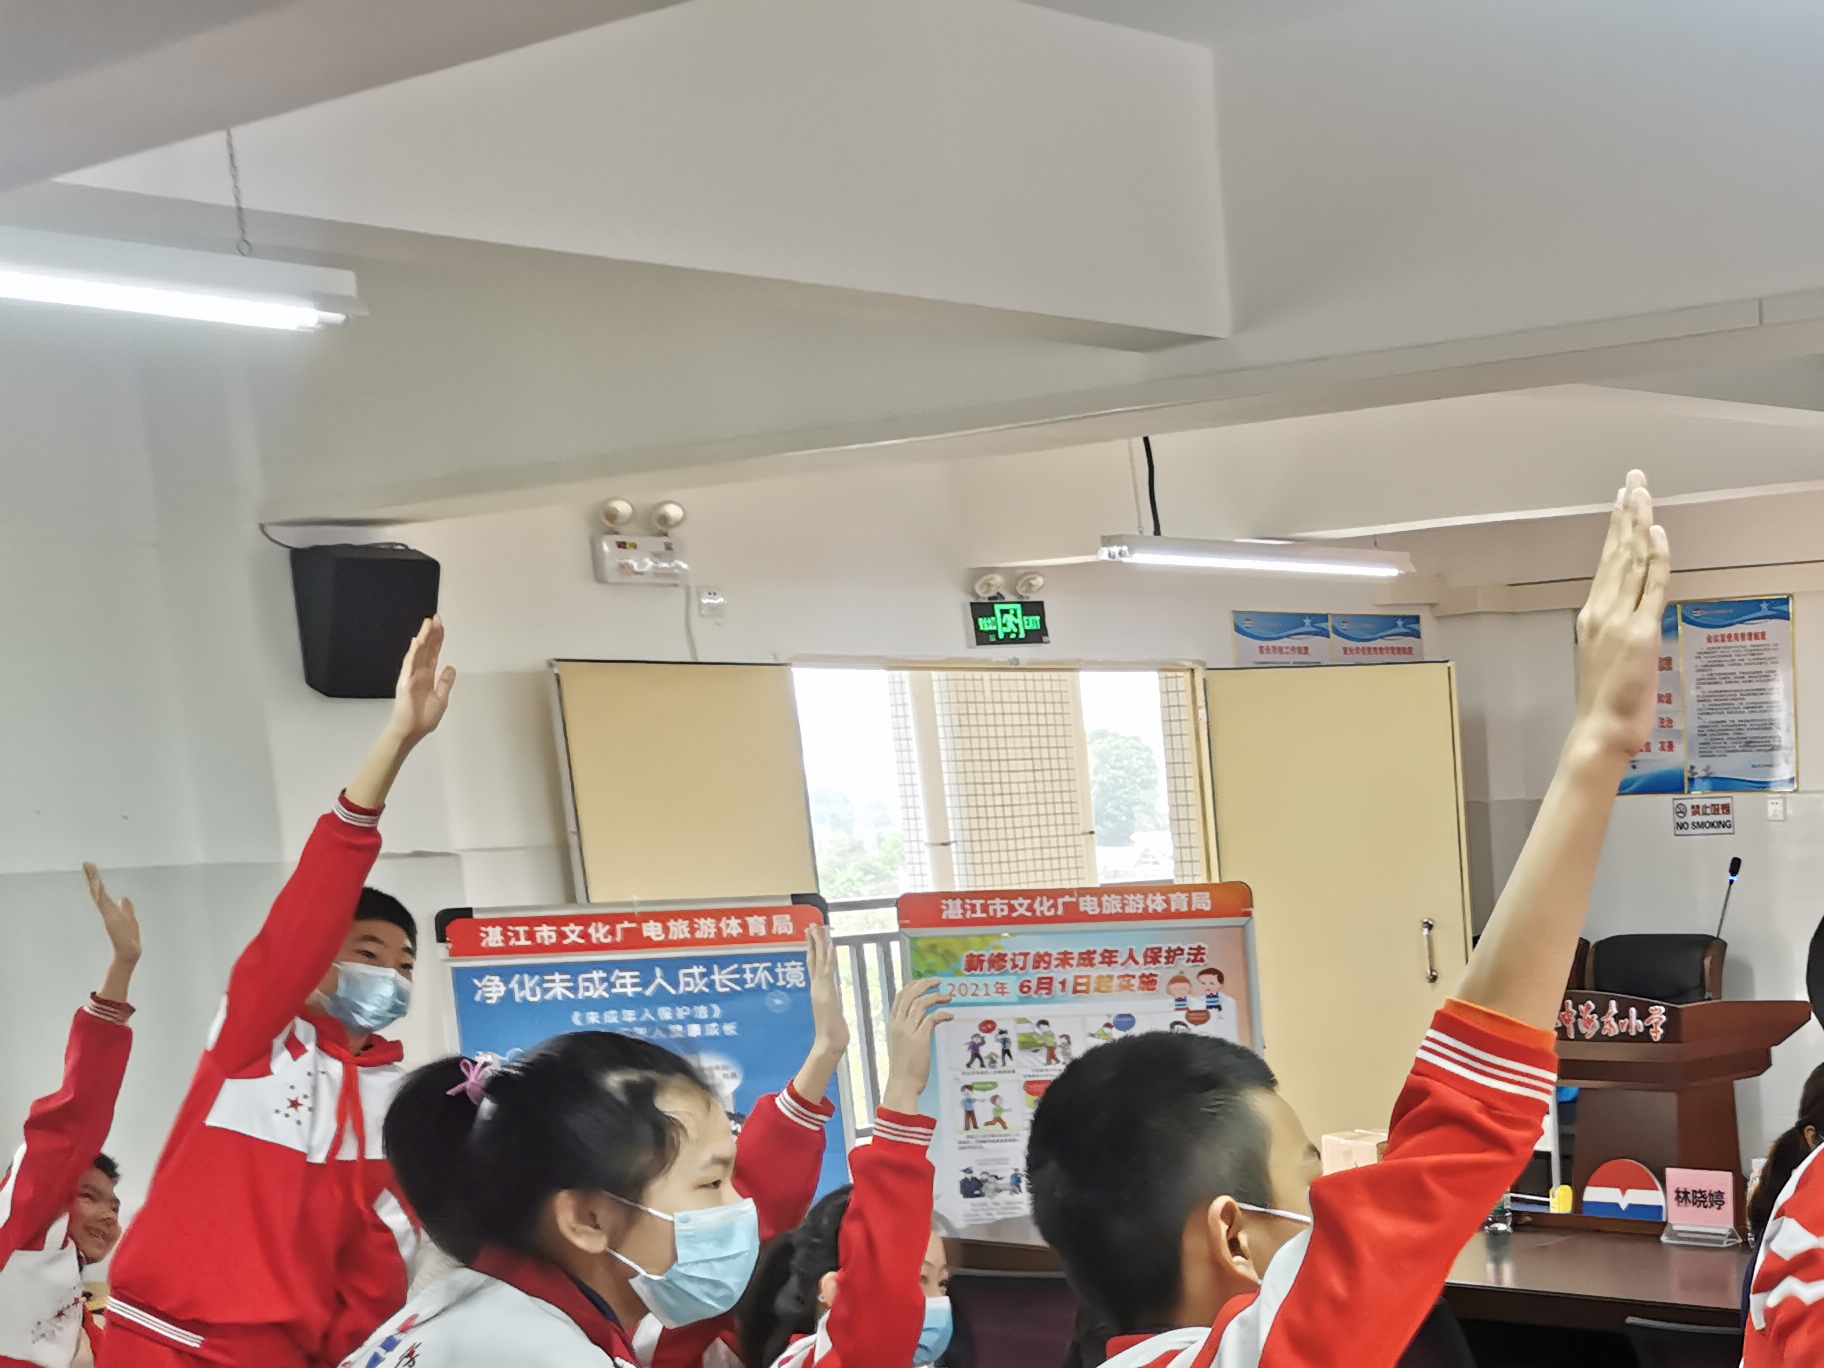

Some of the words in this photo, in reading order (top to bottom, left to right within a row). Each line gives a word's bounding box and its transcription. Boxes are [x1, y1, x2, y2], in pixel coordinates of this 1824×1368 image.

[1676, 821, 1690, 831] NO
[1691, 819, 1732, 831] SMOKING
[941, 891, 1212, 919] 湛江市文化广电旅游体育局
[479, 913, 795, 949] 湛江市文化广电旅游体育局
[963, 944, 1208, 974] 新修订的未成年人保护法
[473, 960, 806, 1005] 净化未成年人成长环境
[949, 980, 1010, 998] 2021年
[1555, 999, 1667, 1041] 中海东小学
[1674, 1187, 1725, 1210] 林晓婷
